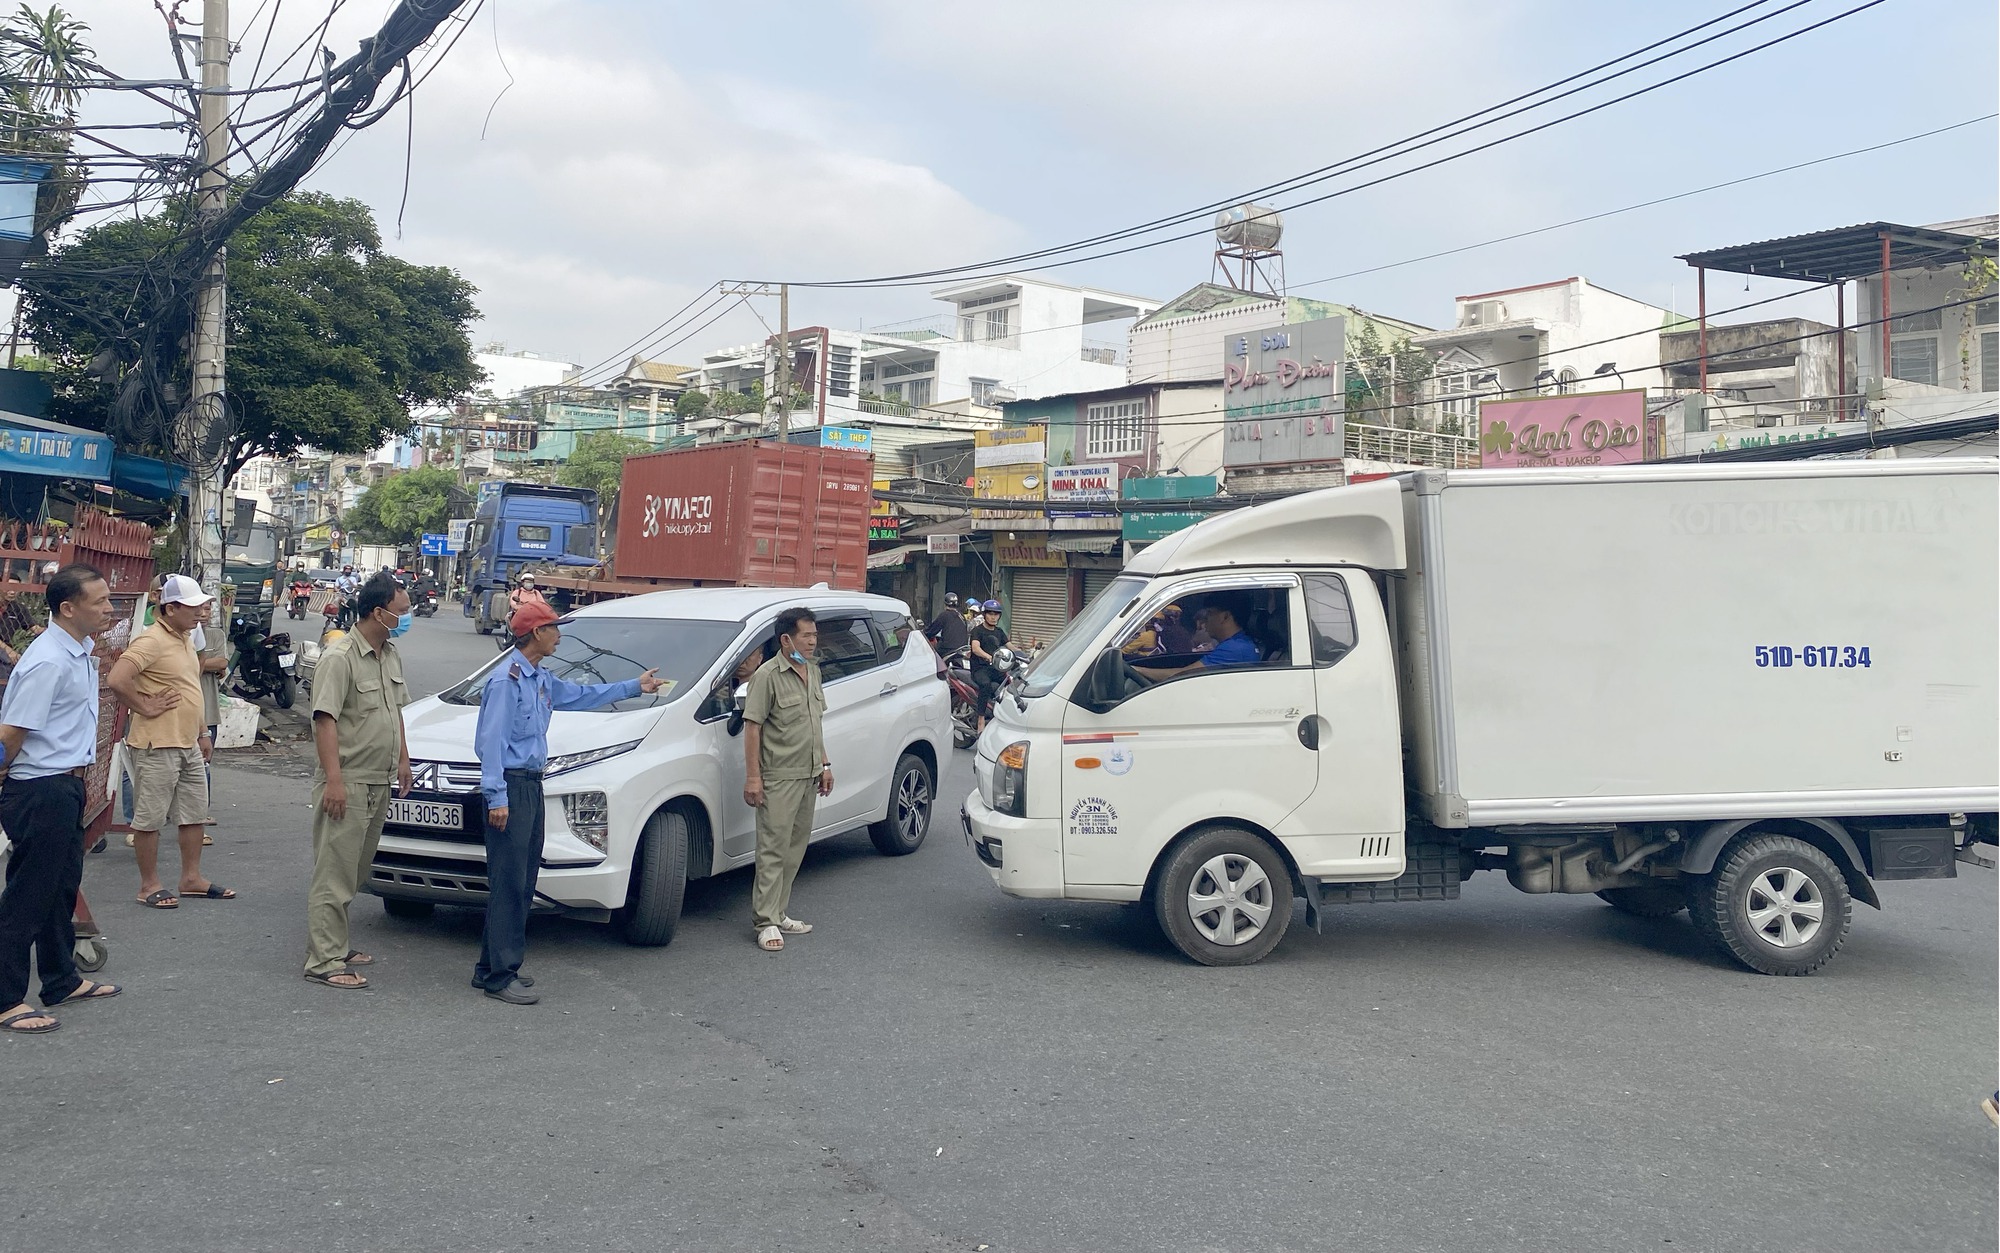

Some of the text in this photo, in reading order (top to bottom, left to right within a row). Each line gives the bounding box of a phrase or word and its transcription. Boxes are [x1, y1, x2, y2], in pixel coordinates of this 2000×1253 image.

[1517, 413, 1582, 458] Anh
[40, 436, 55, 456] TRÀ
[83, 442, 98, 460] 10K
[1052, 477, 1110, 491] MINH KHAI
[1755, 645, 1872, 668] 51D-617.34
[386, 802, 459, 826] 51H-305.36
